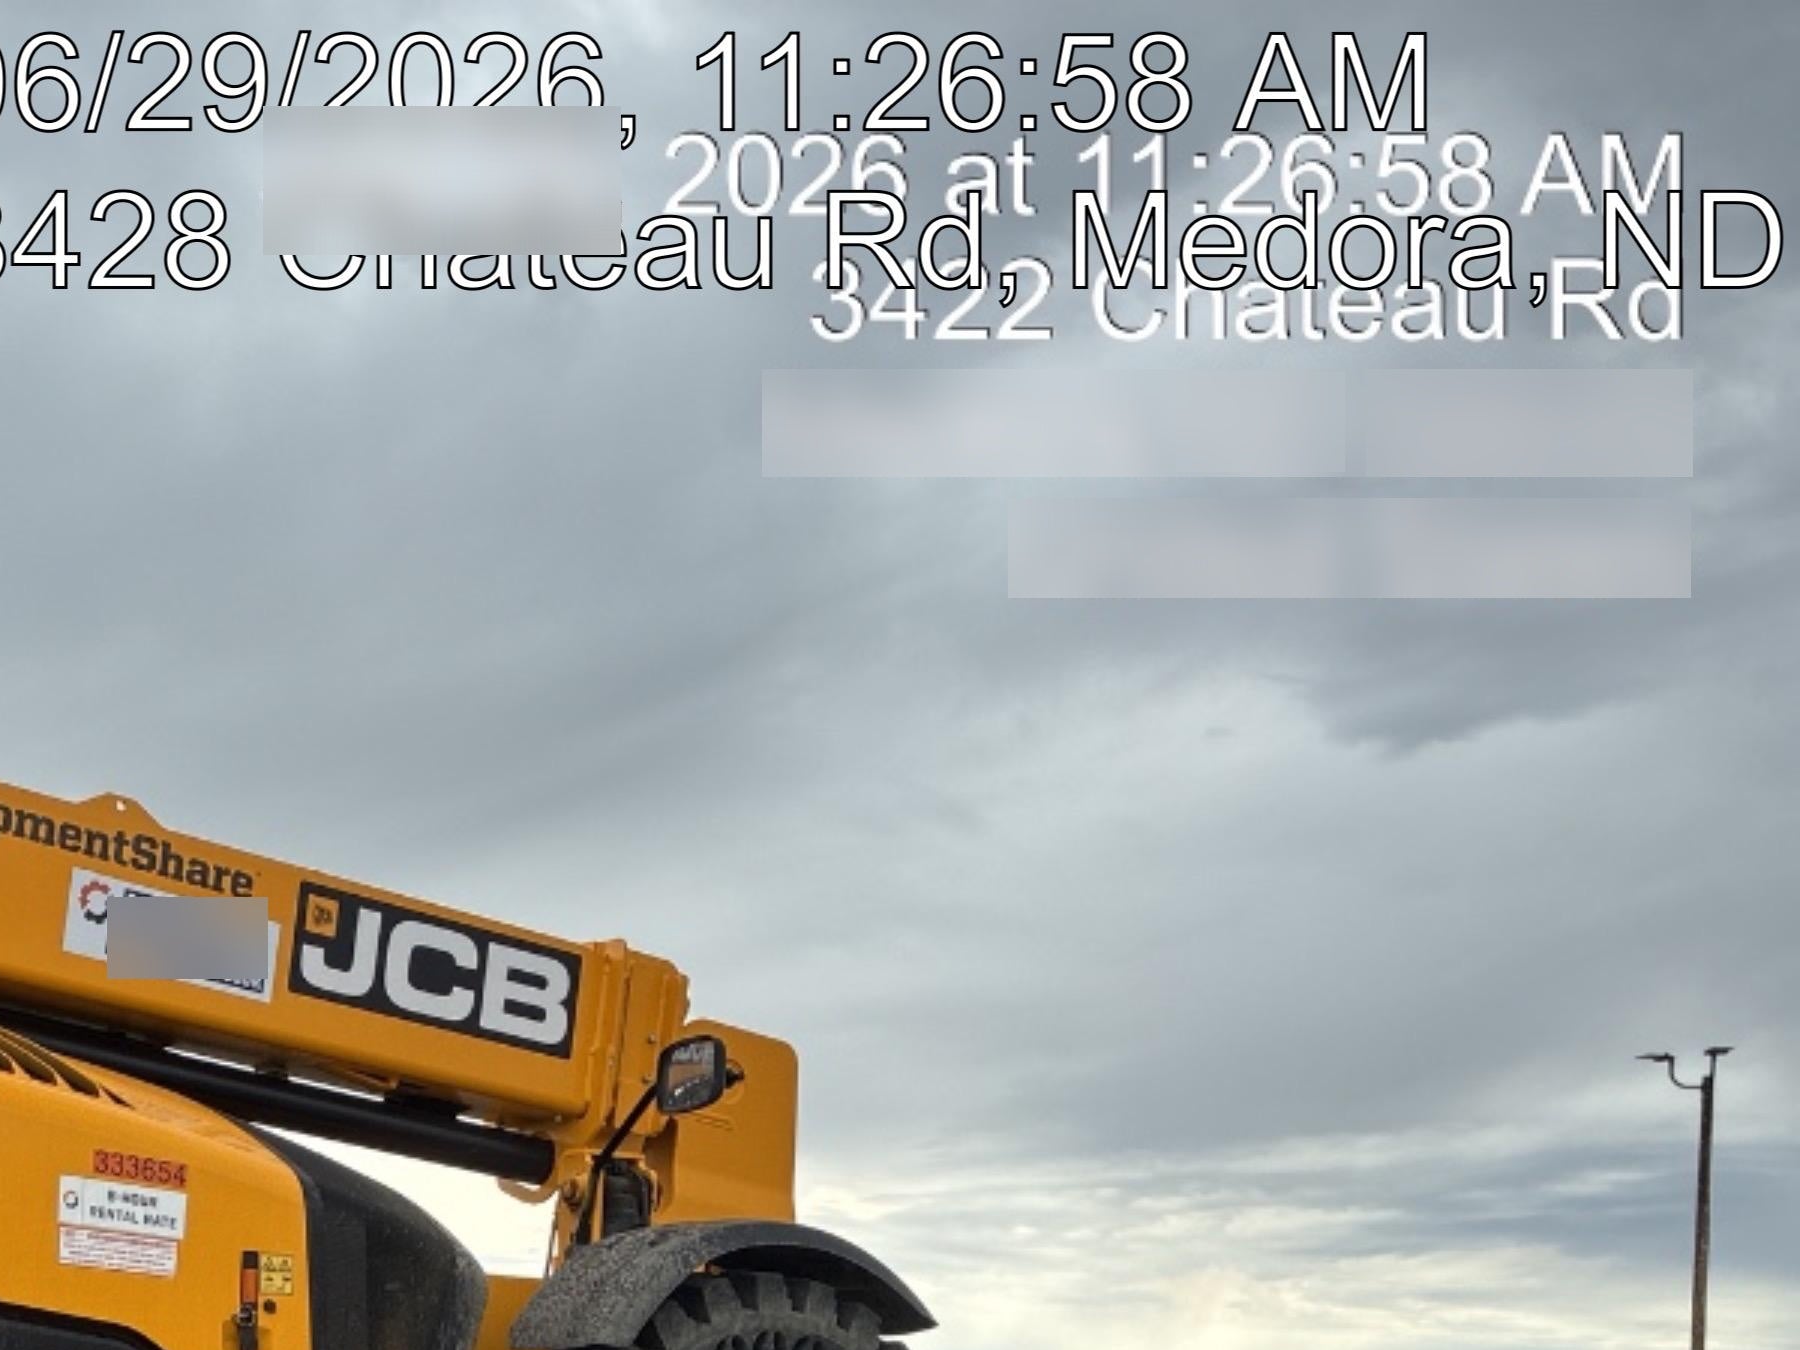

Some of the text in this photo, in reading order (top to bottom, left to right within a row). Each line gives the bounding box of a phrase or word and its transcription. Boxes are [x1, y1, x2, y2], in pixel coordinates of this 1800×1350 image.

[301, 905, 573, 1046] JCB
[94, 1148, 187, 1187] 333654
[89, 1205, 139, 1225] RENTAL
